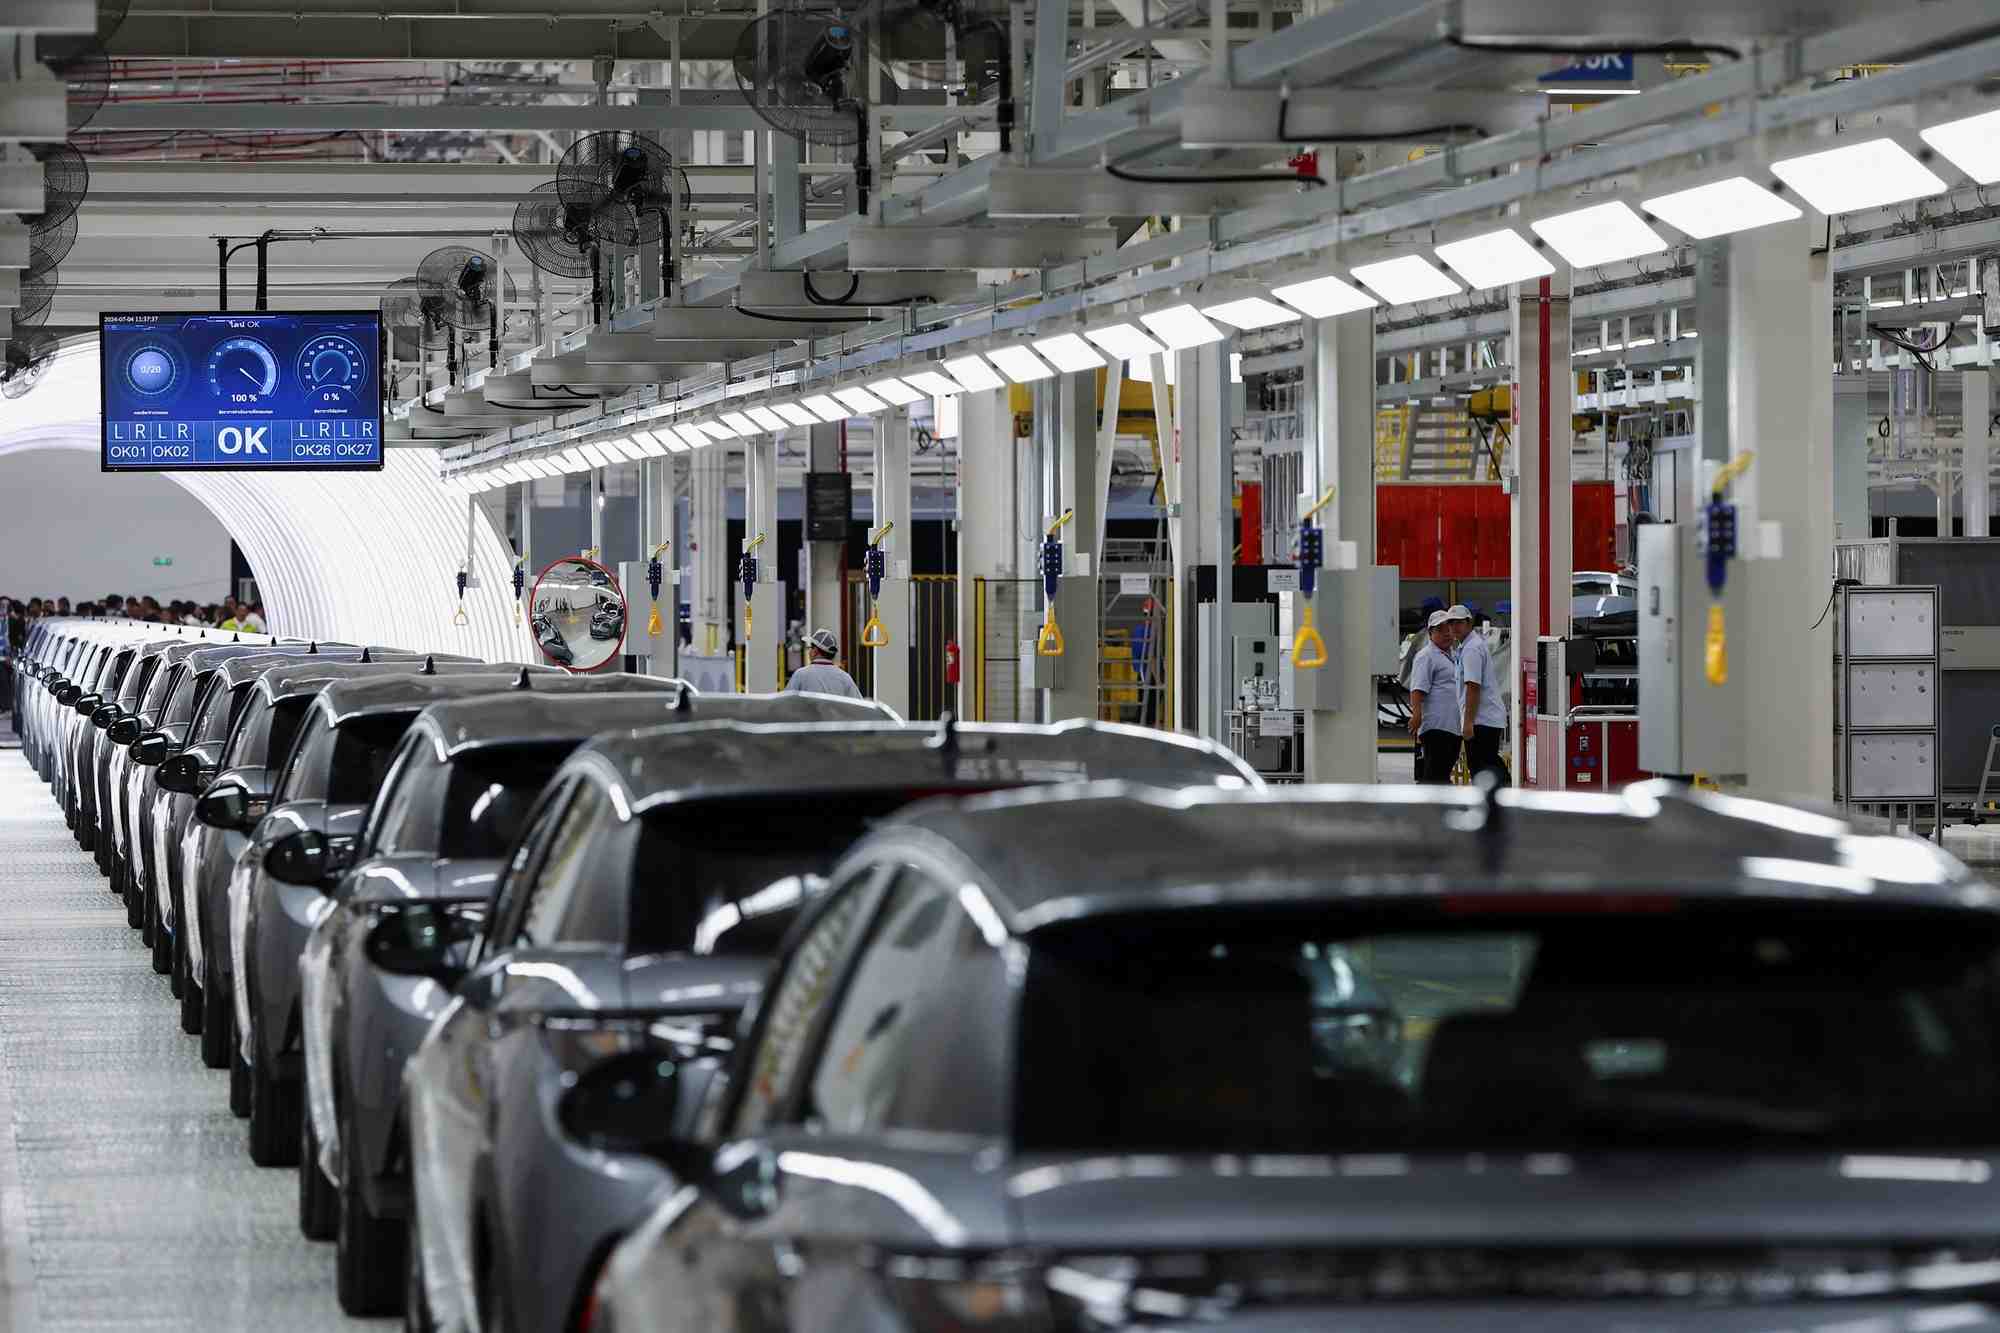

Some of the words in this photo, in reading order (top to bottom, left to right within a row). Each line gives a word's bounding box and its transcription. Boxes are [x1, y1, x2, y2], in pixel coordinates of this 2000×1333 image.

[231, 394, 247, 402] 100
[248, 394, 257, 402] %
[323, 393, 330, 401] 0
[332, 393, 340, 401] %
[114, 424, 122, 439] L
[136, 424, 146, 439] R
[159, 424, 167, 439] L
[178, 424, 188, 439] R
[299, 422, 307, 437] L
[320, 422, 330, 437] R
[342, 422, 350, 437] L
[363, 422, 373, 437] R
[217, 427, 268, 454] OK
[110, 447, 146, 458] OK01
[152, 446, 189, 457] OK02
[294, 444, 331, 456] OK26
[336, 444, 373, 456] OK27
